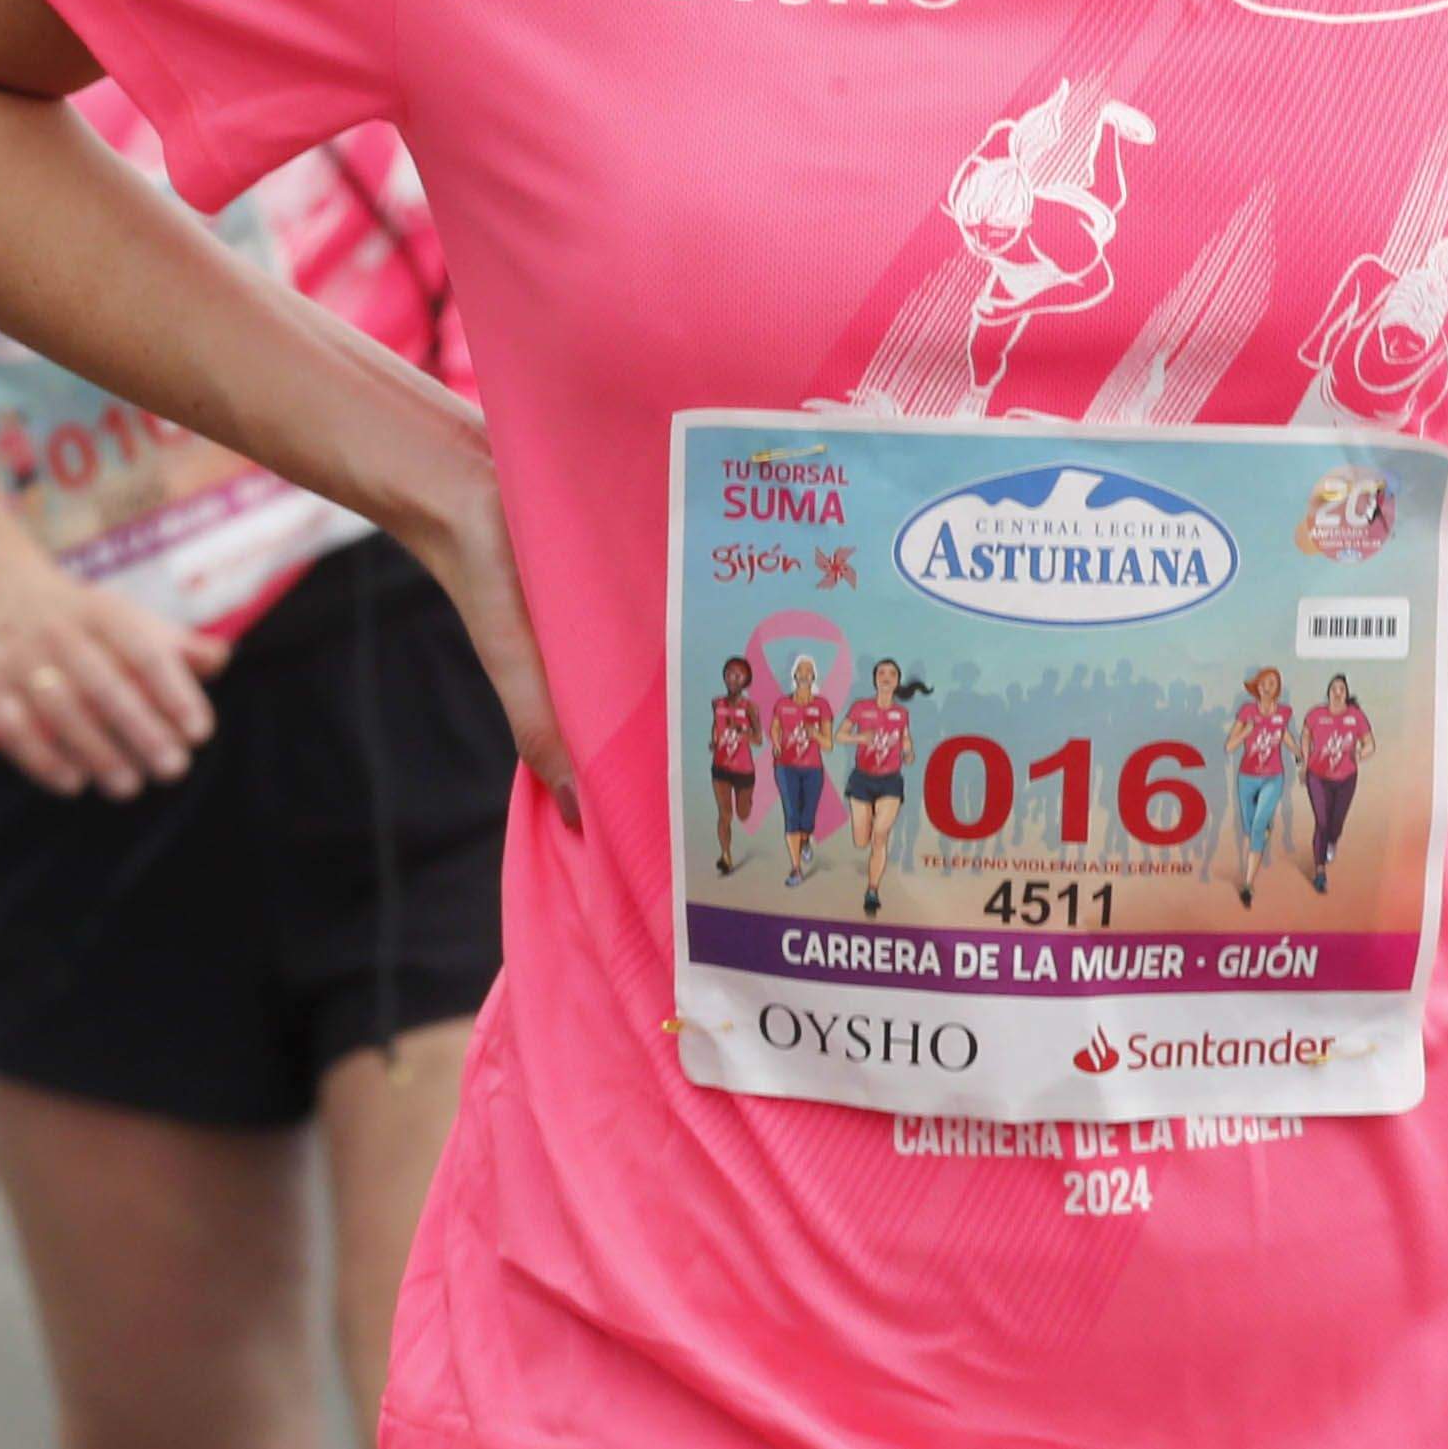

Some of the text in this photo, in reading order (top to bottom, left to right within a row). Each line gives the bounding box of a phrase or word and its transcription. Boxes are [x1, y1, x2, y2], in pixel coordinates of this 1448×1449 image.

[722, 459, 850, 487] TU DORSAL
[723, 484, 846, 526] SUMA
[975, 518, 1203, 540] CENTRAL LECHERA
[920, 520, 1212, 588] ASTURIANA
[923, 734, 1208, 847] 016
[983, 880, 1114, 928] 4511
[781, 928, 941, 977] CARRERA
[954, 942, 1000, 980] DE
[1012, 944, 1058, 982] LA
[1070, 945, 1185, 982] MUJER
[1217, 936, 1318, 979] GIJÓN
[759, 1004, 979, 1073] OYSHO
[1127, 1028, 1337, 1071] Santander
[892, 1115, 1063, 1160] CARRERA
[1073, 1122, 1120, 1160] DE
[1129, 1118, 1174, 1152] LA
[1062, 1165, 1152, 1216] 2024
